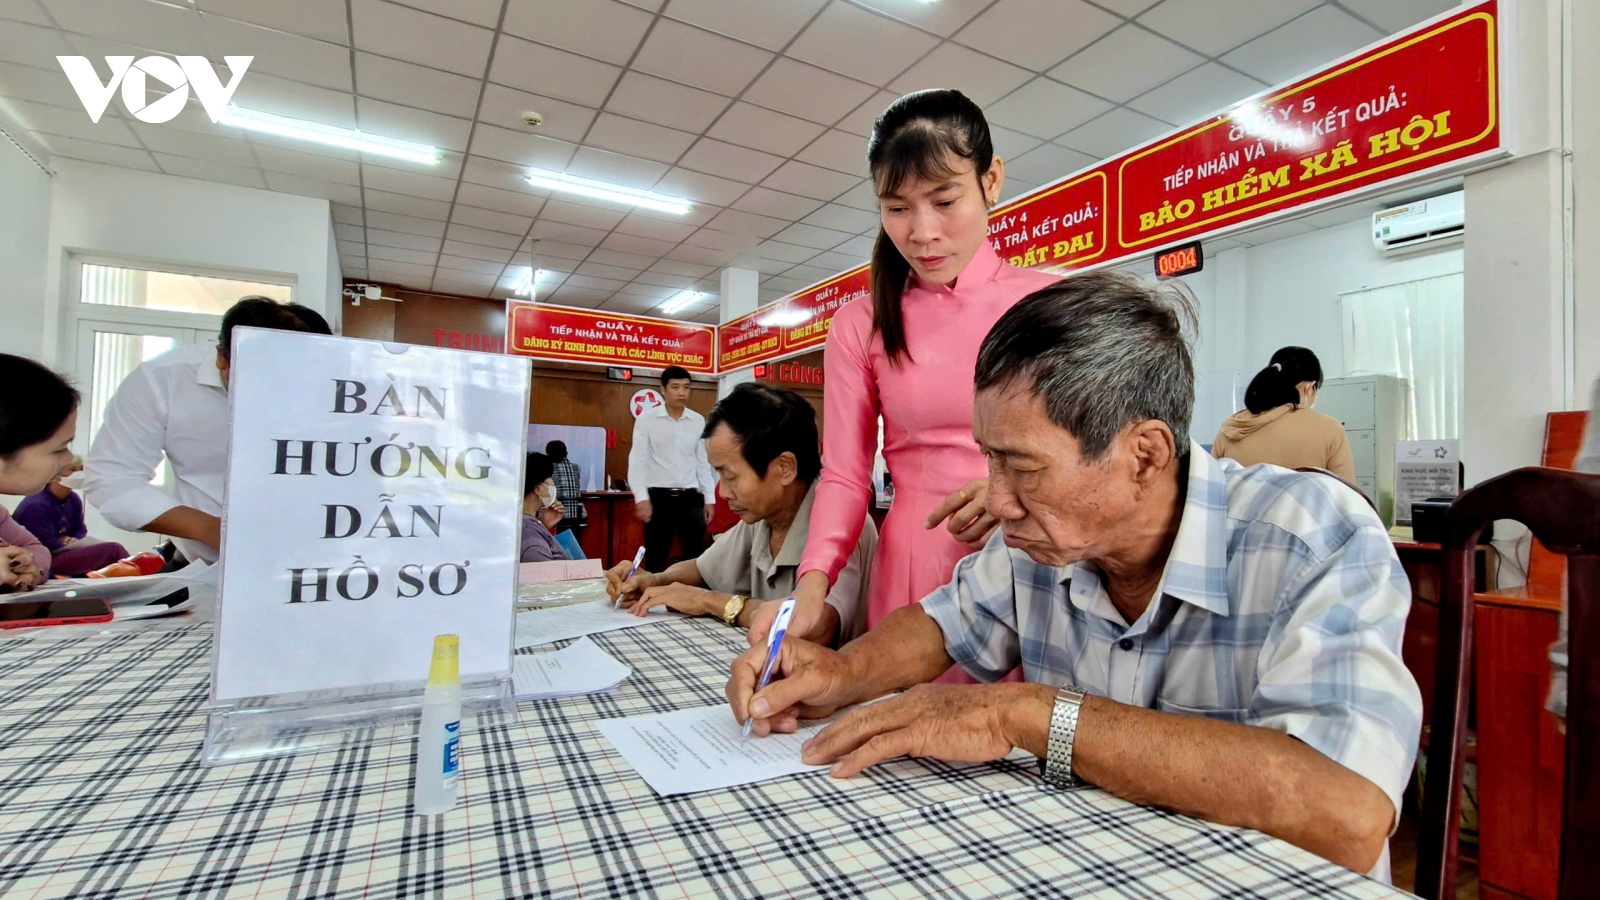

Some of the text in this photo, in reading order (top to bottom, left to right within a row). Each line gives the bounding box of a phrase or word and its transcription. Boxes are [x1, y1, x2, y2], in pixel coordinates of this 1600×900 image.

[1228, 96, 1316, 142] QẦY 5
[1163, 165, 1194, 192] TIẾP
[1197, 151, 1240, 180] NHẬN
[1244, 138, 1266, 162] VÀ
[1312, 106, 1349, 138] KẾT
[1355, 85, 1407, 121] QUẢ:
[1139, 110, 1451, 232] BẢO HIỂM XÃ HỘI
[1004, 226, 1029, 248] TRẢ
[1032, 216, 1059, 239] KẾT
[1062, 201, 1099, 228] QUẢ:
[1020, 212, 1028, 223] 4
[1008, 231, 1094, 268] ĐẤT ĐAI
[1158, 246, 1198, 275] 0004
[818, 302, 826, 314] VÀ
[826, 296, 838, 310] TRẢ
[834, 286, 839, 295] 3
[433, 329, 505, 353] TRUN
[523, 337, 549, 349] ĐĂNG
[550, 339, 563, 350] KÝ
[564, 341, 585, 352] KINH
[587, 344, 615, 356] DOANH
[616, 344, 628, 356] VÀ
[629, 347, 646, 358] CÁC
[667, 351, 682, 363] VỰC
[683, 352, 704, 364] KHÁC
[550, 325, 573, 336] TIẾP
[575, 328, 603, 340] NHẬN
[605, 330, 618, 341] VÀ
[621, 333, 639, 344] TRẢ
[641, 335, 659, 346] KẾT
[780, 361, 824, 384] CÔNG
[329, 372, 450, 421] BÀN
[269, 433, 493, 480] HƯỚNG
[319, 493, 446, 539] DẪN
[285, 555, 471, 605] HỒ SƠ
